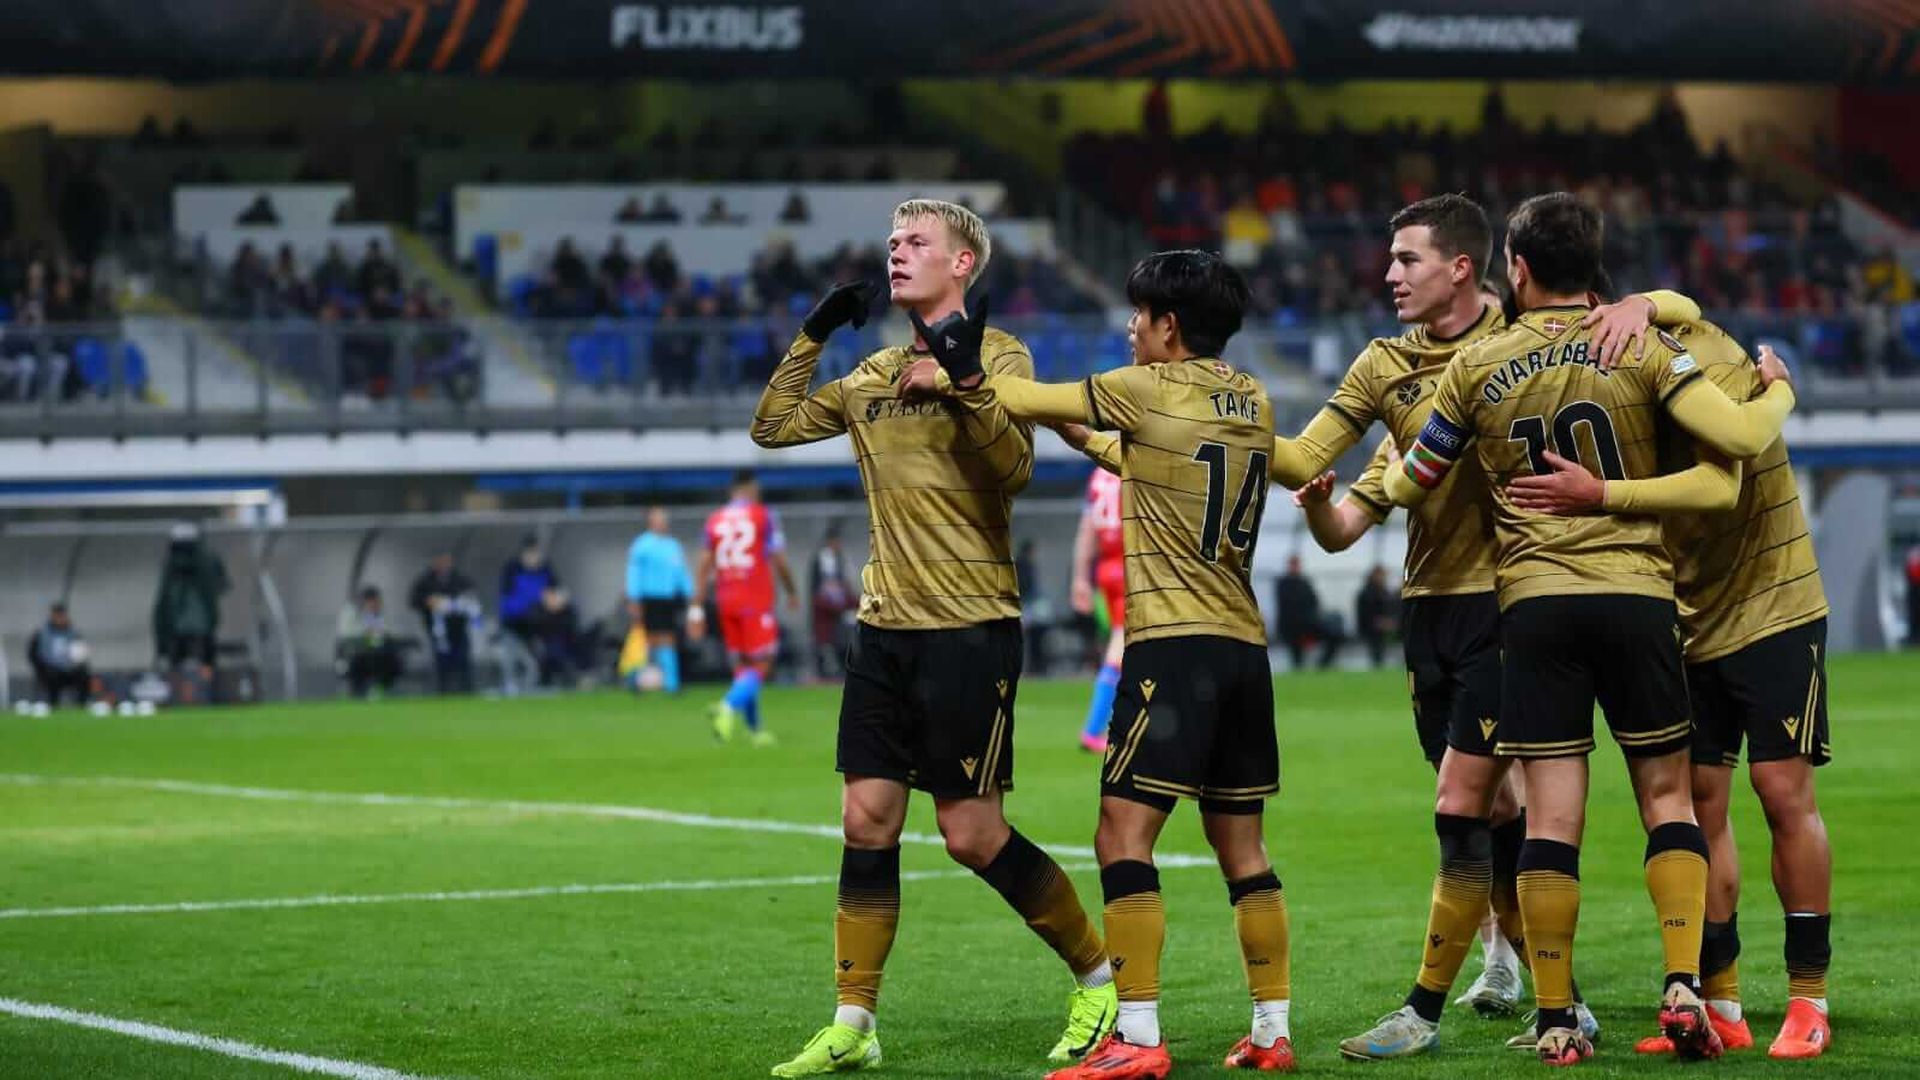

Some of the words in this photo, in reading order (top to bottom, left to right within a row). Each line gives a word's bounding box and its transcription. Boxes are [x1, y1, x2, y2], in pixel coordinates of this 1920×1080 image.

[1483, 340, 1611, 405] OYARZABA
[1209, 392, 1259, 424] TAKE
[1427, 421, 1460, 449] RESPEC
[1508, 400, 1627, 478] 10
[1192, 441, 1268, 571] 14
[713, 520, 756, 569] 22
